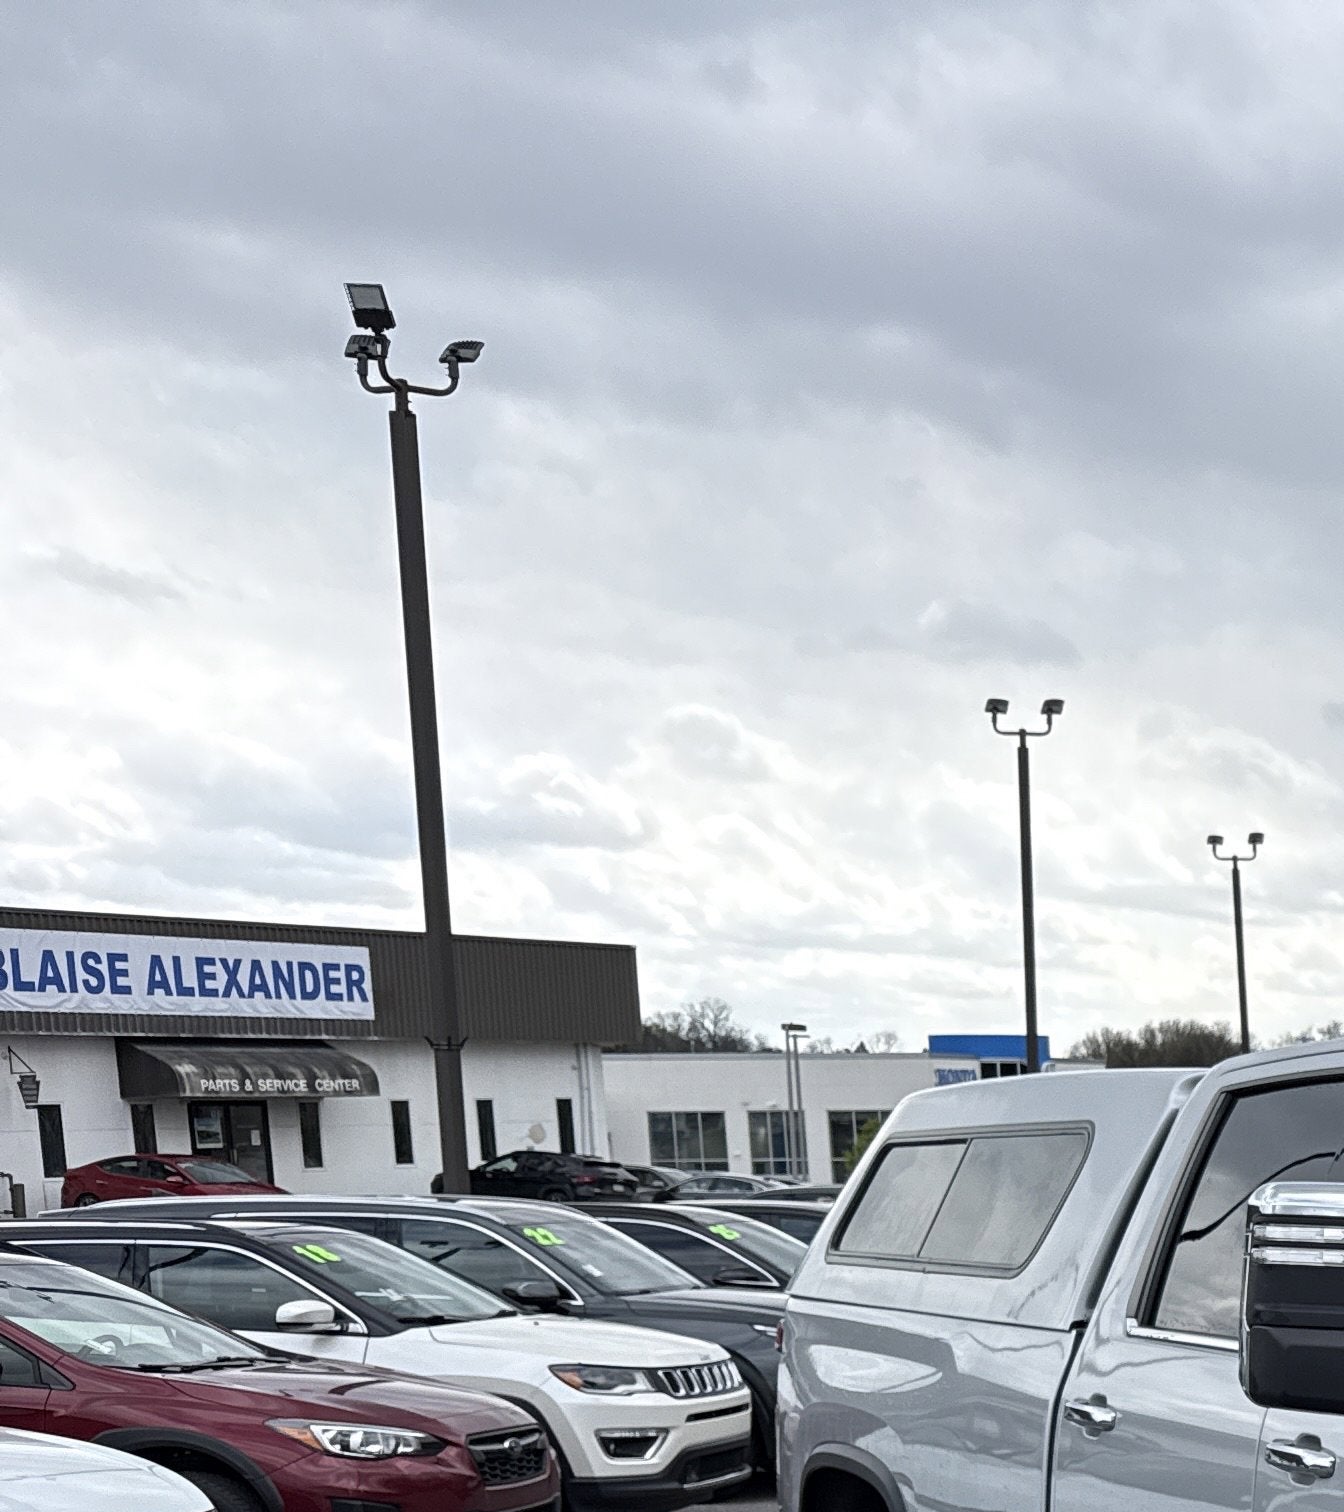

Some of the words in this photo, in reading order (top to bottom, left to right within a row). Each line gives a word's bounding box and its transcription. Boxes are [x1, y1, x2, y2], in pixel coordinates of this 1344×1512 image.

[0, 947, 132, 995] LAISE
[147, 954, 370, 1002] ALEXANDER
[200, 1079, 240, 1092] PARTS
[244, 1079, 254, 1092] &
[258, 1079, 309, 1092] SERVICE
[315, 1078, 361, 1092] CENTER
